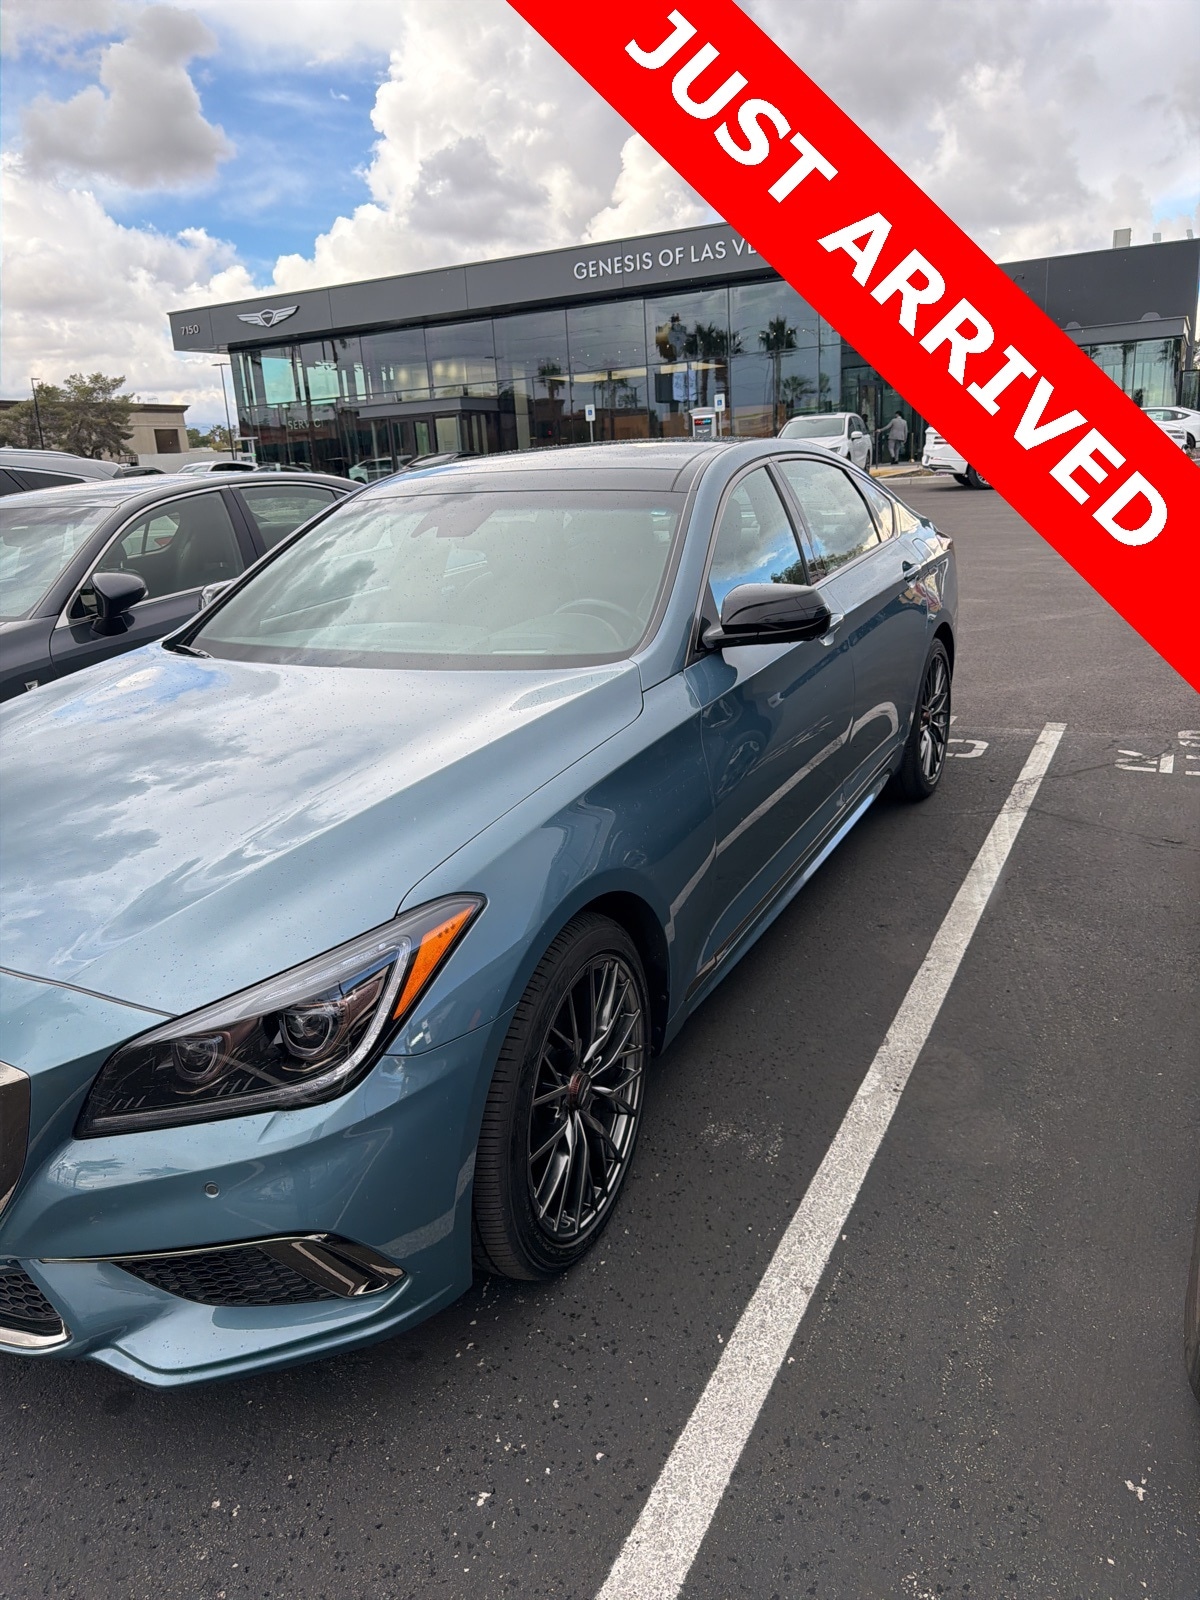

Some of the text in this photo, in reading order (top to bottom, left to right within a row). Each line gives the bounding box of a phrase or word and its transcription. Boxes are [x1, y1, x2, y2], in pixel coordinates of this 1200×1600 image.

[573, 251, 653, 280] GENESIS
[658, 246, 685, 267] OF
[690, 240, 727, 263] LAS
[180, 324, 199, 336] 7150
[287, 418, 324, 430] SERVC
